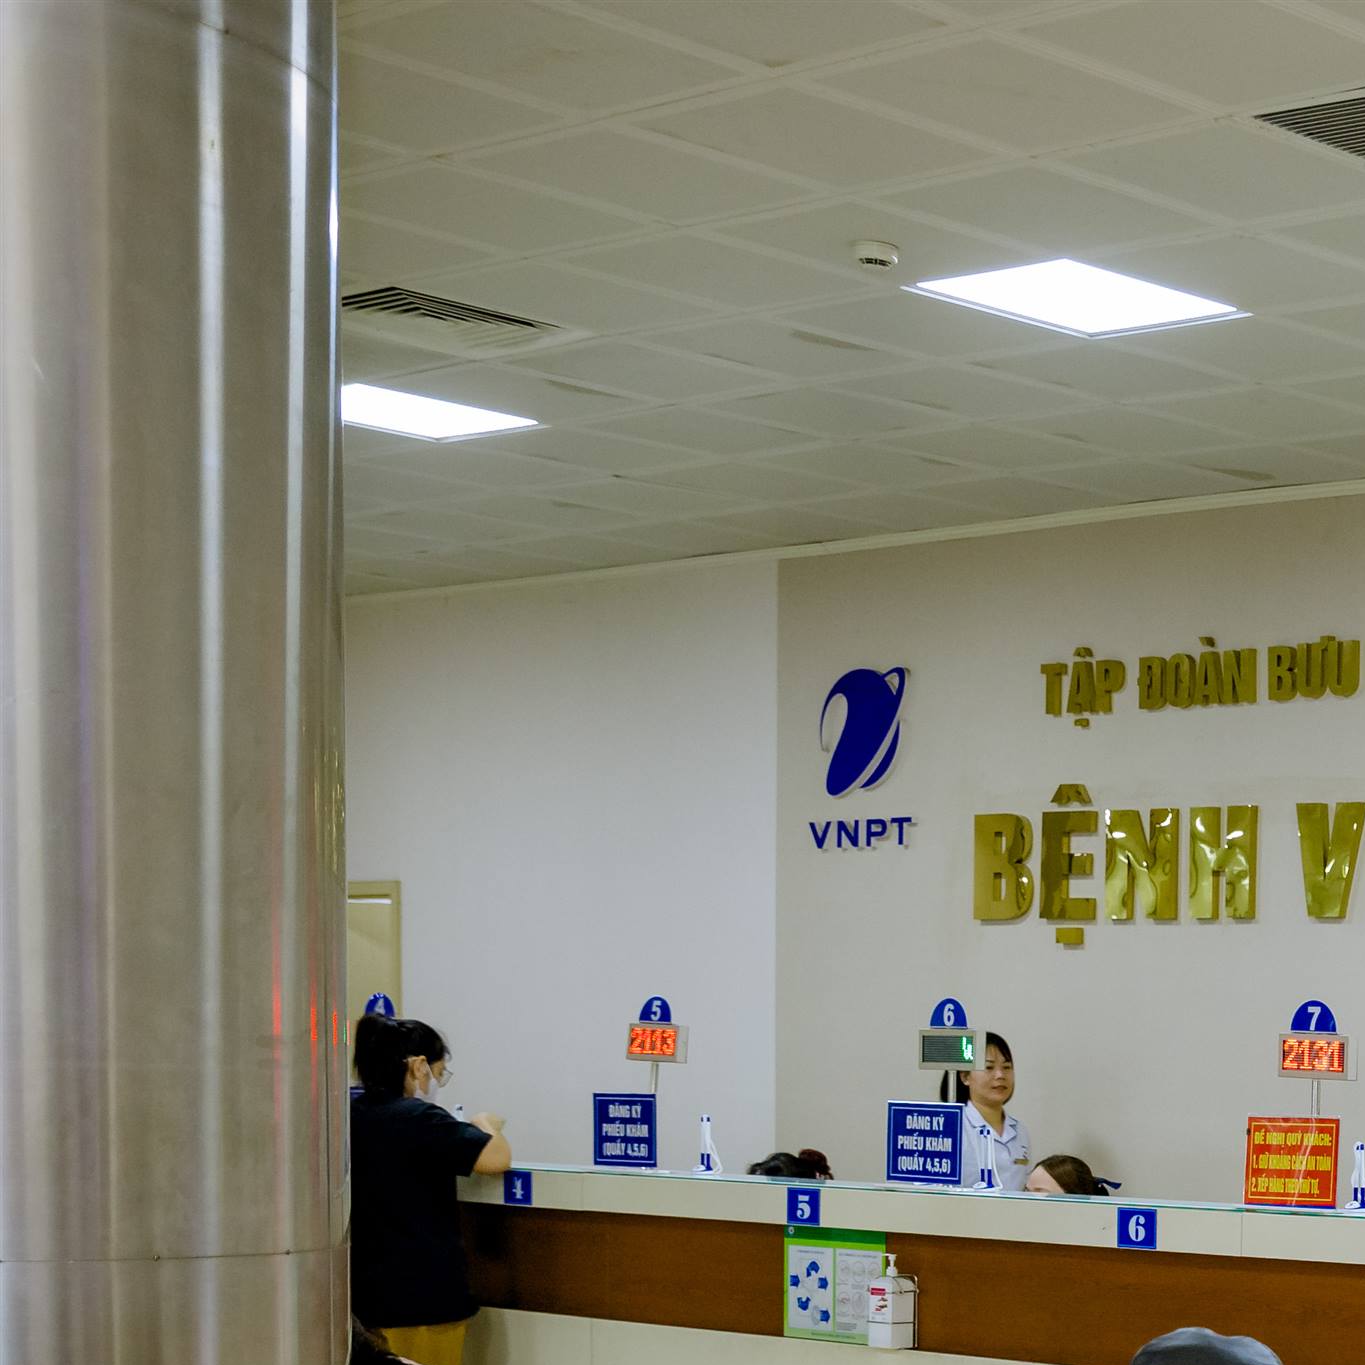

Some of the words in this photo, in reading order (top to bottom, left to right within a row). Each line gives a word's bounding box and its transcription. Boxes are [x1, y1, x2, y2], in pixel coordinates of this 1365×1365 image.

[1040, 646, 1125, 728] TẬP
[1138, 636, 1257, 711] ĐOÀN
[1268, 635, 1360, 701] BƯU
[809, 815, 913, 849] VNPT
[972, 783, 1259, 945] BỆNH
[650, 1000, 662, 1021] 5
[943, 1003, 955, 1027] 6
[1308, 1006, 1321, 1031] 7
[1283, 1039, 1343, 1072] 2131
[906, 1112, 930, 1130] ĐĂNG
[933, 1113, 944, 1131] KÝ
[897, 1132, 923, 1150] PHIẾU
[925, 1135, 952, 1152] KHÁM
[926, 1157, 951, 1174] 4,5,6)
[797, 1195, 811, 1220] 5
[1129, 1214, 1145, 1242] 6
